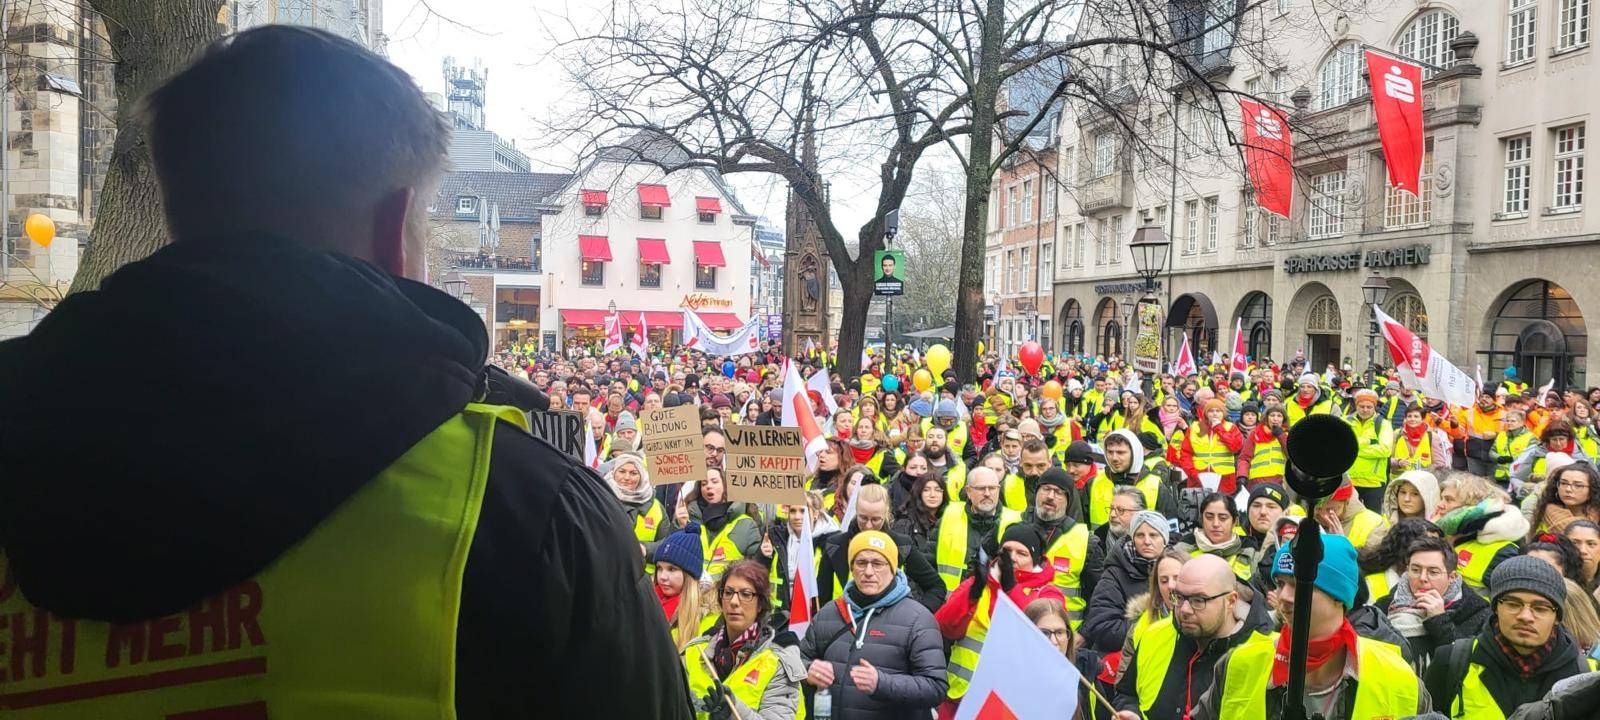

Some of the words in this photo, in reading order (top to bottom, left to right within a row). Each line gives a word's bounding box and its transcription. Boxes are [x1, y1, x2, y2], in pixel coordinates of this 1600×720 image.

[1283, 251, 1360, 273] SPARKASSE
[1364, 246, 1429, 267] AACHEN
[650, 409, 675, 421] GUTE
[644, 420, 688, 436] BILDUNG
[724, 429, 758, 447] WIR
[759, 429, 800, 447] LERNEN
[658, 465, 694, 476] ANGEBOT
[736, 456, 756, 469] UNS
[760, 457, 801, 471] KAPUTT
[730, 474, 747, 488] ZU
[753, 474, 803, 490] ARBEITEN
[106, 580, 266, 669] MEHR
